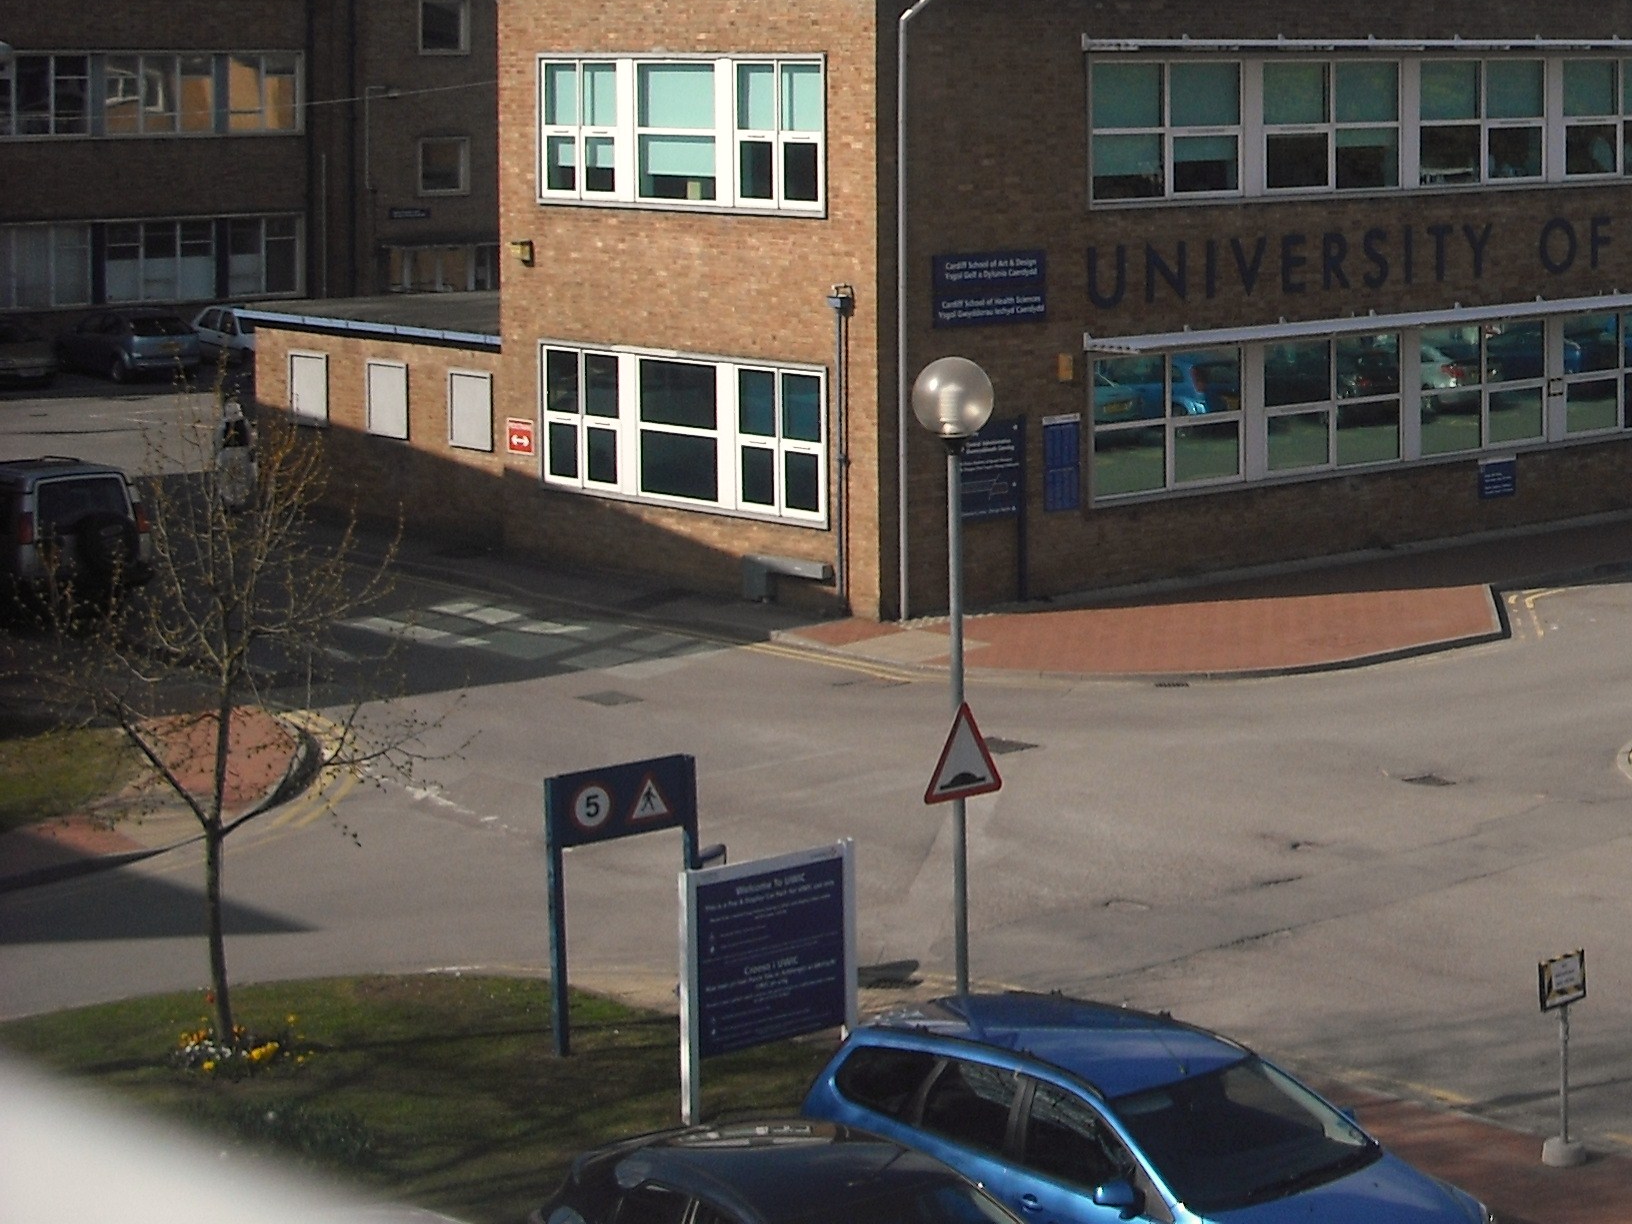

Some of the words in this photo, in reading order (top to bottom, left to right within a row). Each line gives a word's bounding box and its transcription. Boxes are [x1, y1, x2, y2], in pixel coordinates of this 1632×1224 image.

[1086, 223, 1494, 311] UNIVERSITY
[1538, 216, 1612, 275] OF
[585, 794, 599, 818] 5
